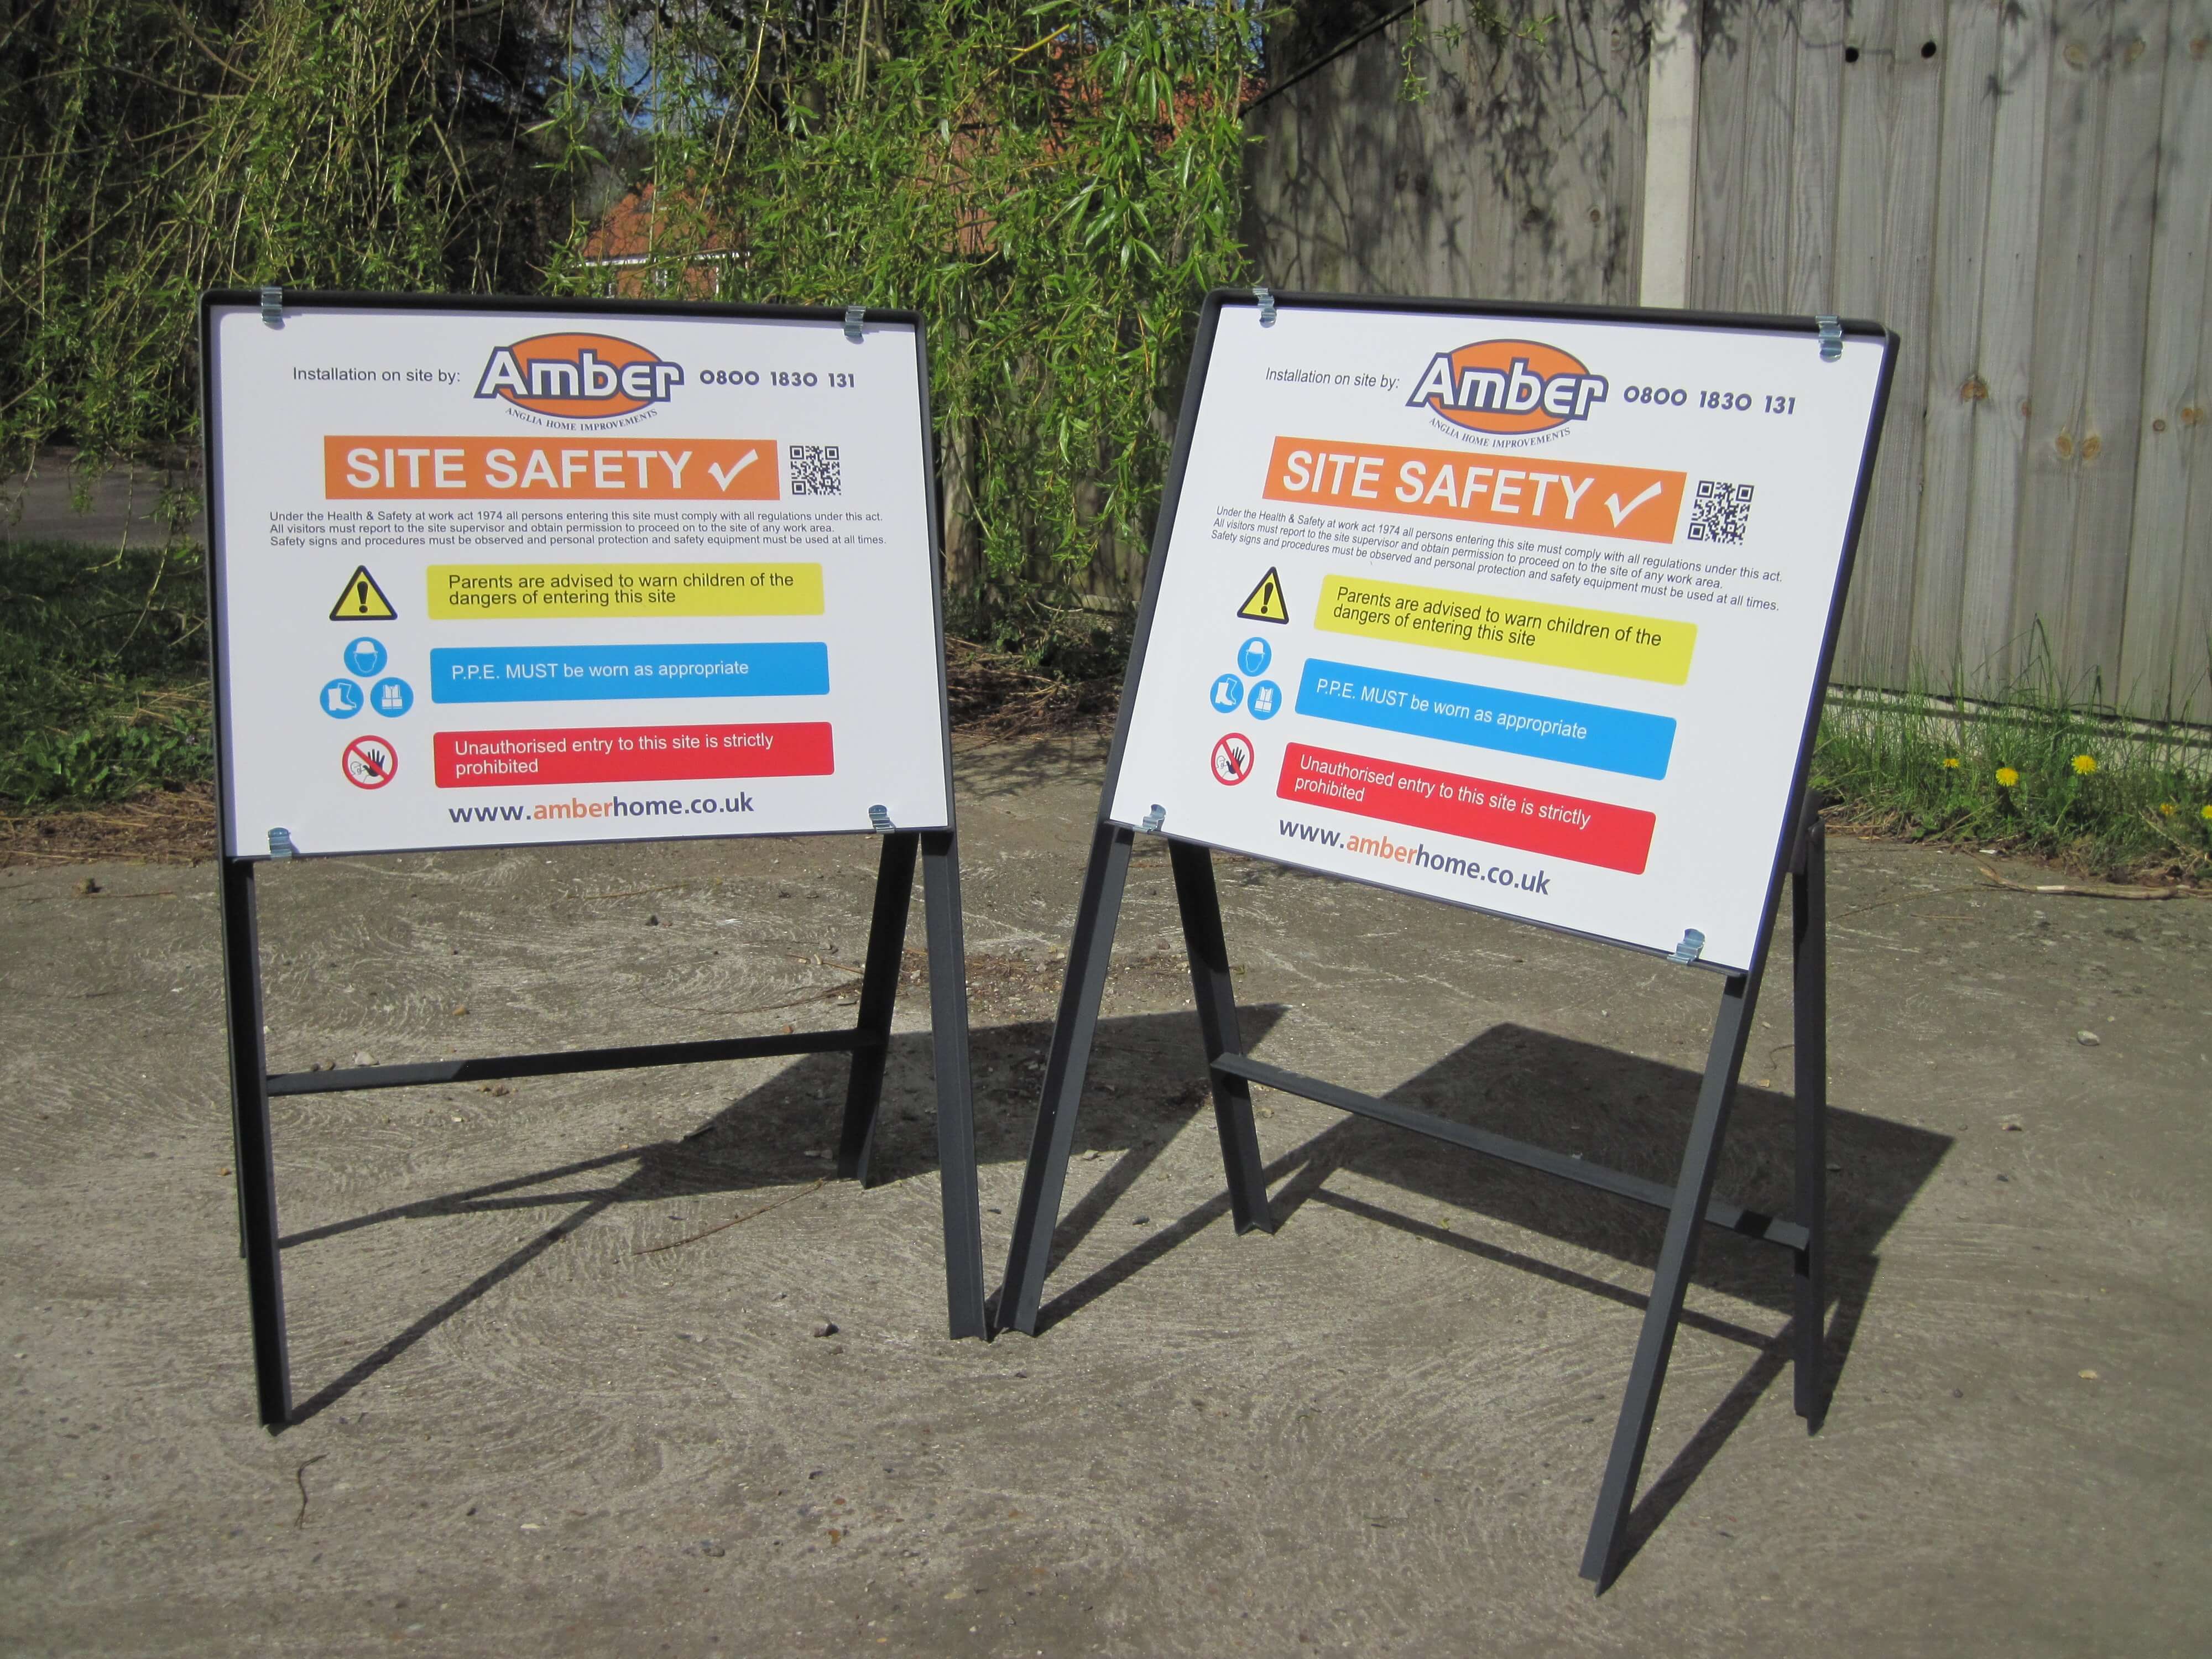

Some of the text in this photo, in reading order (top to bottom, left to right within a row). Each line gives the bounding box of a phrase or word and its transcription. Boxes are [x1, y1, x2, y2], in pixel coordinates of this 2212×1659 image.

[294, 367, 460, 385] Installation on site by:
[473, 346, 685, 402] Amber
[700, 369, 854, 388] 0800 1830 131
[1266, 367, 1400, 392] Installation on site by:
[1405, 352, 1609, 421] Amber
[1624, 385, 1796, 415] 0800 1830 131
[505, 407, 658, 431] ANGLIA HOME IMPROVEMENTS
[1429, 417, 1571, 448] ANGLIA HOME IMPROVEMENTS
[346, 448, 693, 489] SITE SAFETY
[1283, 450, 1595, 520] SITE SAFETY
[270, 510, 883, 523] Under the Health & Safety at work act 1974 all persons entering this site must comply with all regulations under this act.
[1217, 506, 1336, 529] Under the Health & Safety at
[270, 524, 284, 533] All
[287, 524, 326, 533] visitors
[329, 524, 356, 533] must
[359, 524, 391, 535] report
[394, 524, 404, 533] to
[408, 523, 424, 533] the
[427, 524, 446, 533] site
[450, 523, 505, 535] supervisor
[508, 523, 528, 532] and
[531, 523, 563, 532] obtain
[566, 525, 622, 534] permission
[625, 523, 635, 532] to
[638, 523, 679, 534] proceed
[698, 523, 708, 532] to
[711, 523, 726, 532] the
[729, 524, 747, 532] site
[750, 523, 759, 532] of
[763, 525, 780, 534] any
[783, 523, 807, 532] work
[270, 535, 886, 548] Safety signs and procedures must be observed and personal protection and safety equipment must be used at all times.
[449, 572, 794, 589] Parents are advised to warn children of the
[449, 588, 676, 608] dangers of entering this site
[1333, 603, 1536, 646] dangers of entering this site
[1337, 586, 1661, 646] Parents are advised to warn children of the
[452, 660, 748, 680] P.P.E. MUST be worn as appropriate
[1316, 678, 1587, 739] P.P.E. MUST be worn as appropriate
[455, 732, 773, 755] Unauthorised entry to this site is strictly
[456, 758, 538, 779] prohibited
[1295, 778, 1365, 802] prohibited
[1300, 754, 1591, 830] Unauthorised entry to this site is strictly
[448, 791, 754, 823] www.amberhome.co.uk
[1280, 820, 1551, 895] www.amberhome.co.uk
